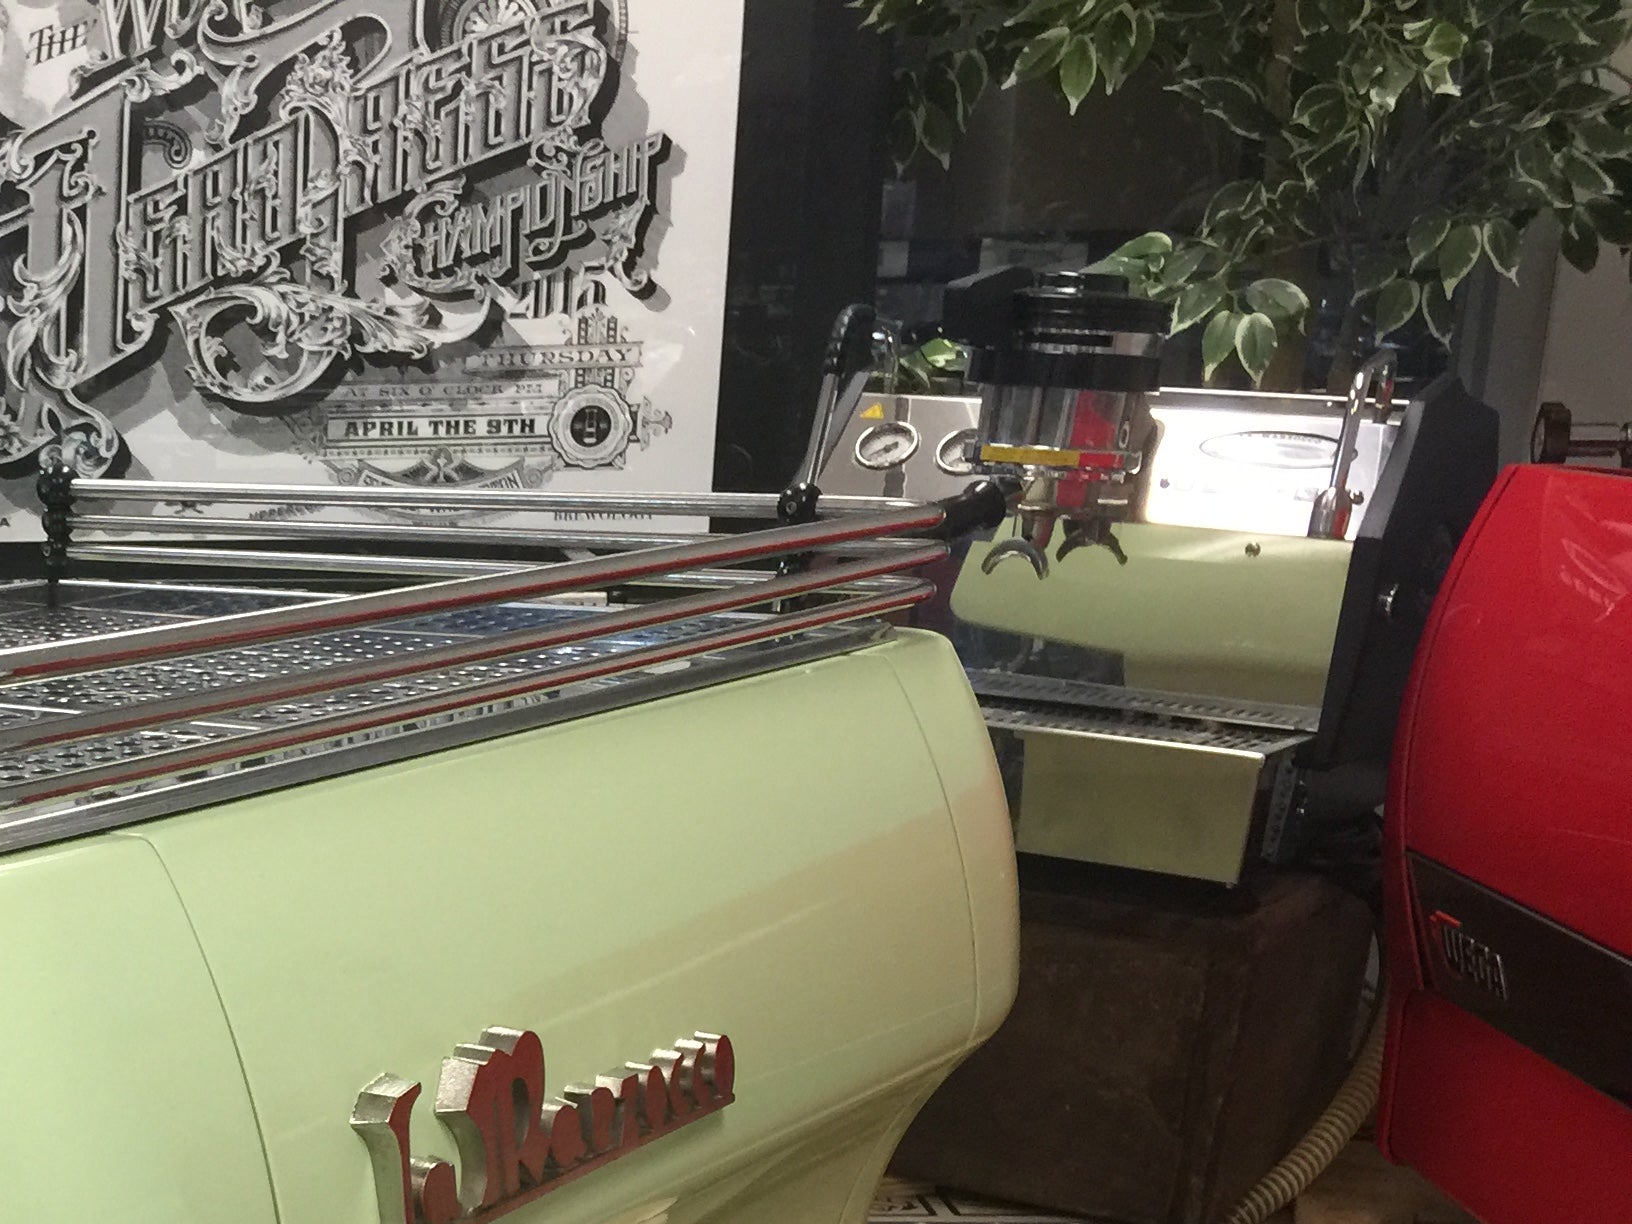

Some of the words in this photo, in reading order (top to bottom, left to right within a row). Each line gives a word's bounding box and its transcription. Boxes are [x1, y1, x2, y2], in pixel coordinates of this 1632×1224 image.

[479, 348, 631, 366] THURSDAY
[378, 385, 411, 398] SIX
[442, 383, 505, 396] CLOCK
[514, 382, 544, 395] PM
[344, 419, 420, 438] APRIL
[428, 419, 478, 437] THE
[485, 417, 537, 436] 9TH
